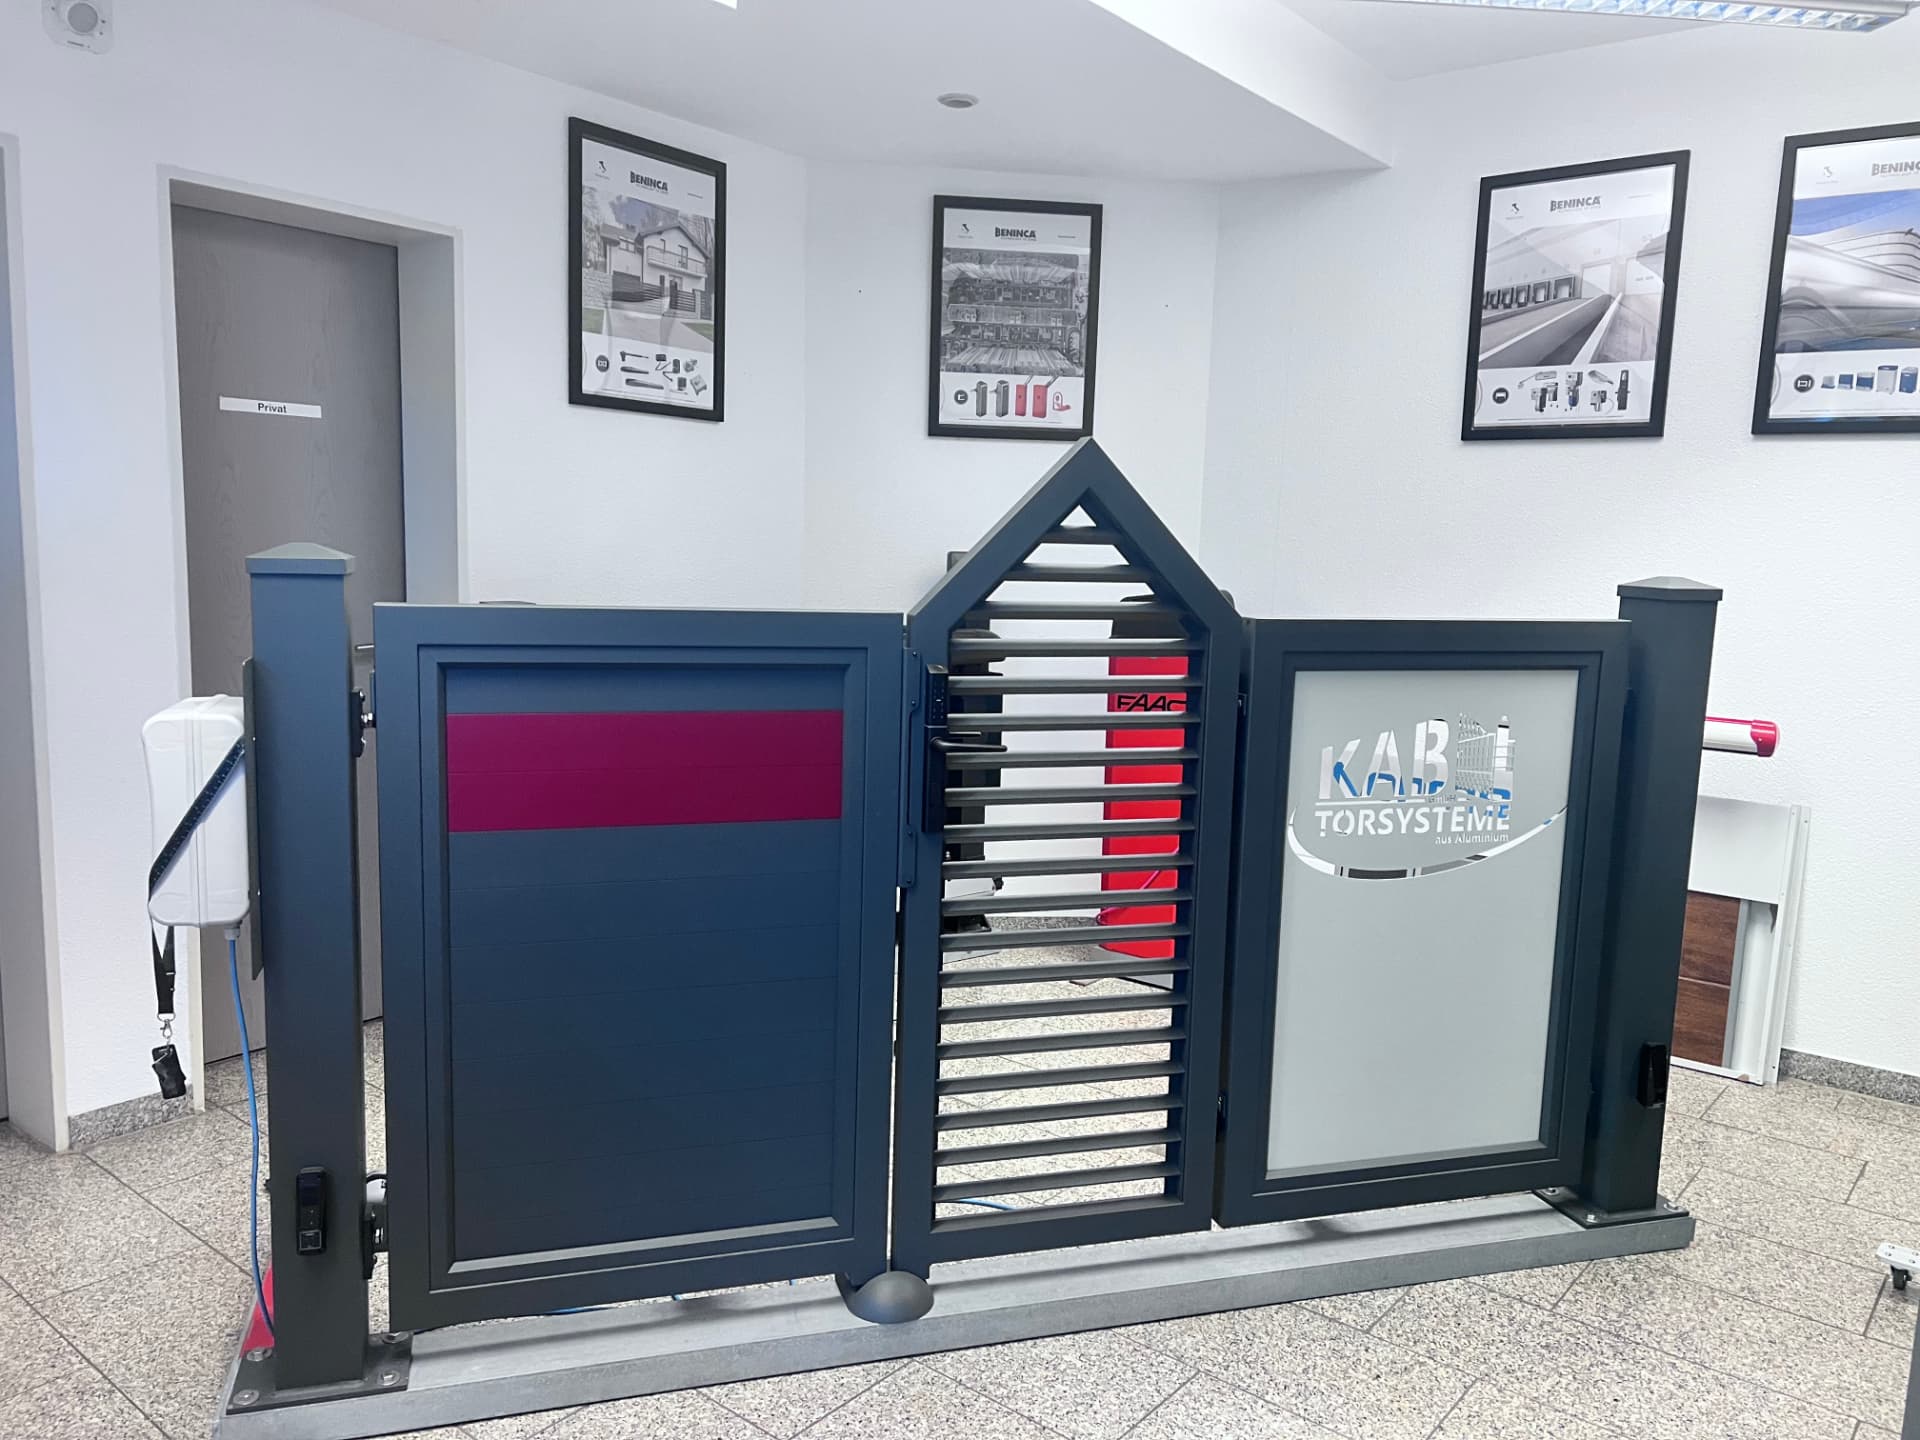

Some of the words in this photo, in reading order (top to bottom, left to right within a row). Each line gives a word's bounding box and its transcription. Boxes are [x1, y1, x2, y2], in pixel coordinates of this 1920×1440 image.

[1871, 160, 1920, 176] BENINC
[257, 402, 287, 414] Privat
[1318, 718, 1450, 800] KAB
[1314, 803, 1511, 837] TORSYSTEME
[1454, 832, 1509, 844] Aluminium
